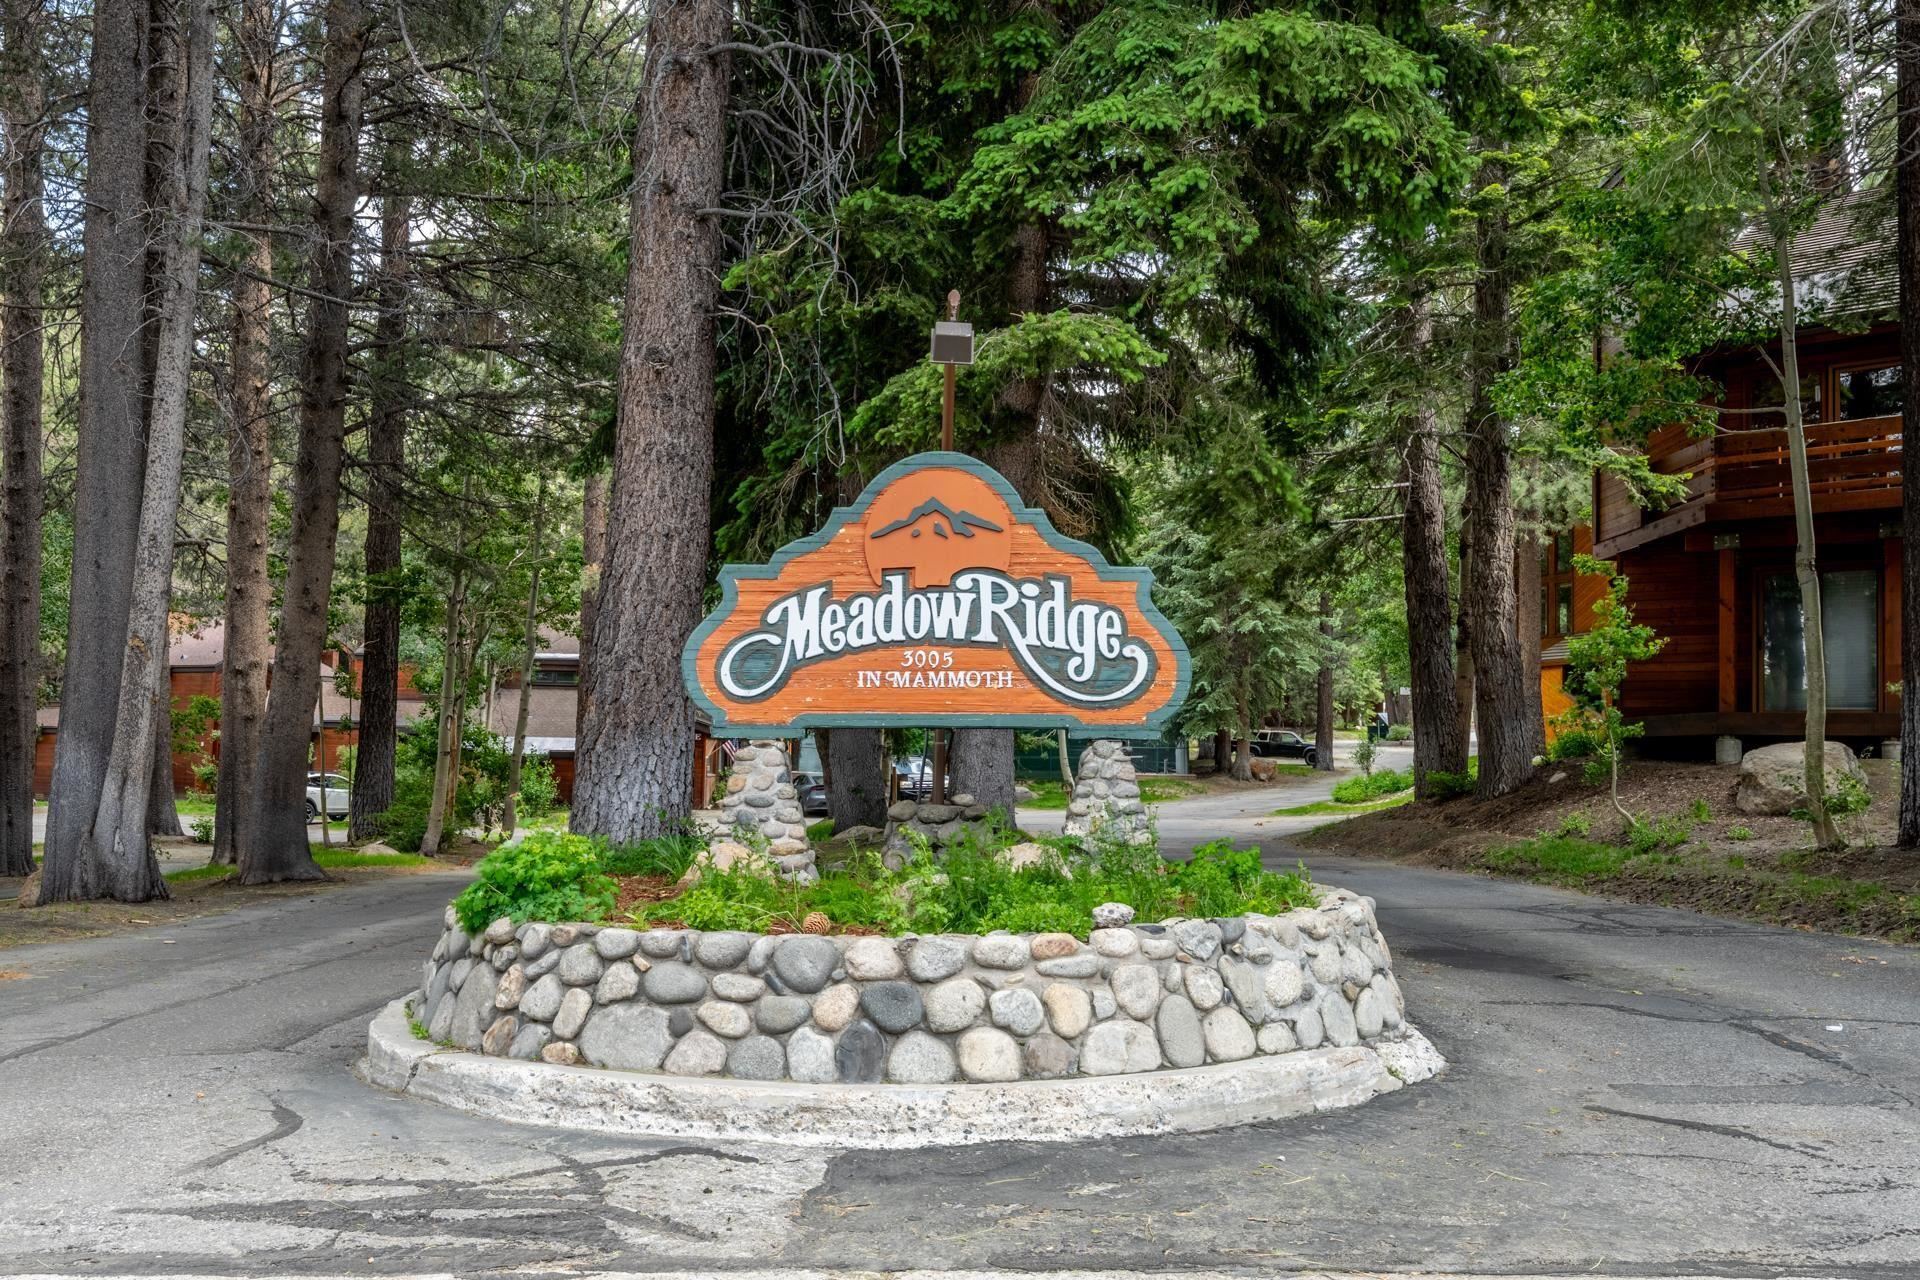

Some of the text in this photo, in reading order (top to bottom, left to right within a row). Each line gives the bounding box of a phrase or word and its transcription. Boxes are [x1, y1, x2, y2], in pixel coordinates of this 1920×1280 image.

[901, 650, 953, 668] 3005
[857, 670, 1014, 688] IN MAMMOTH
